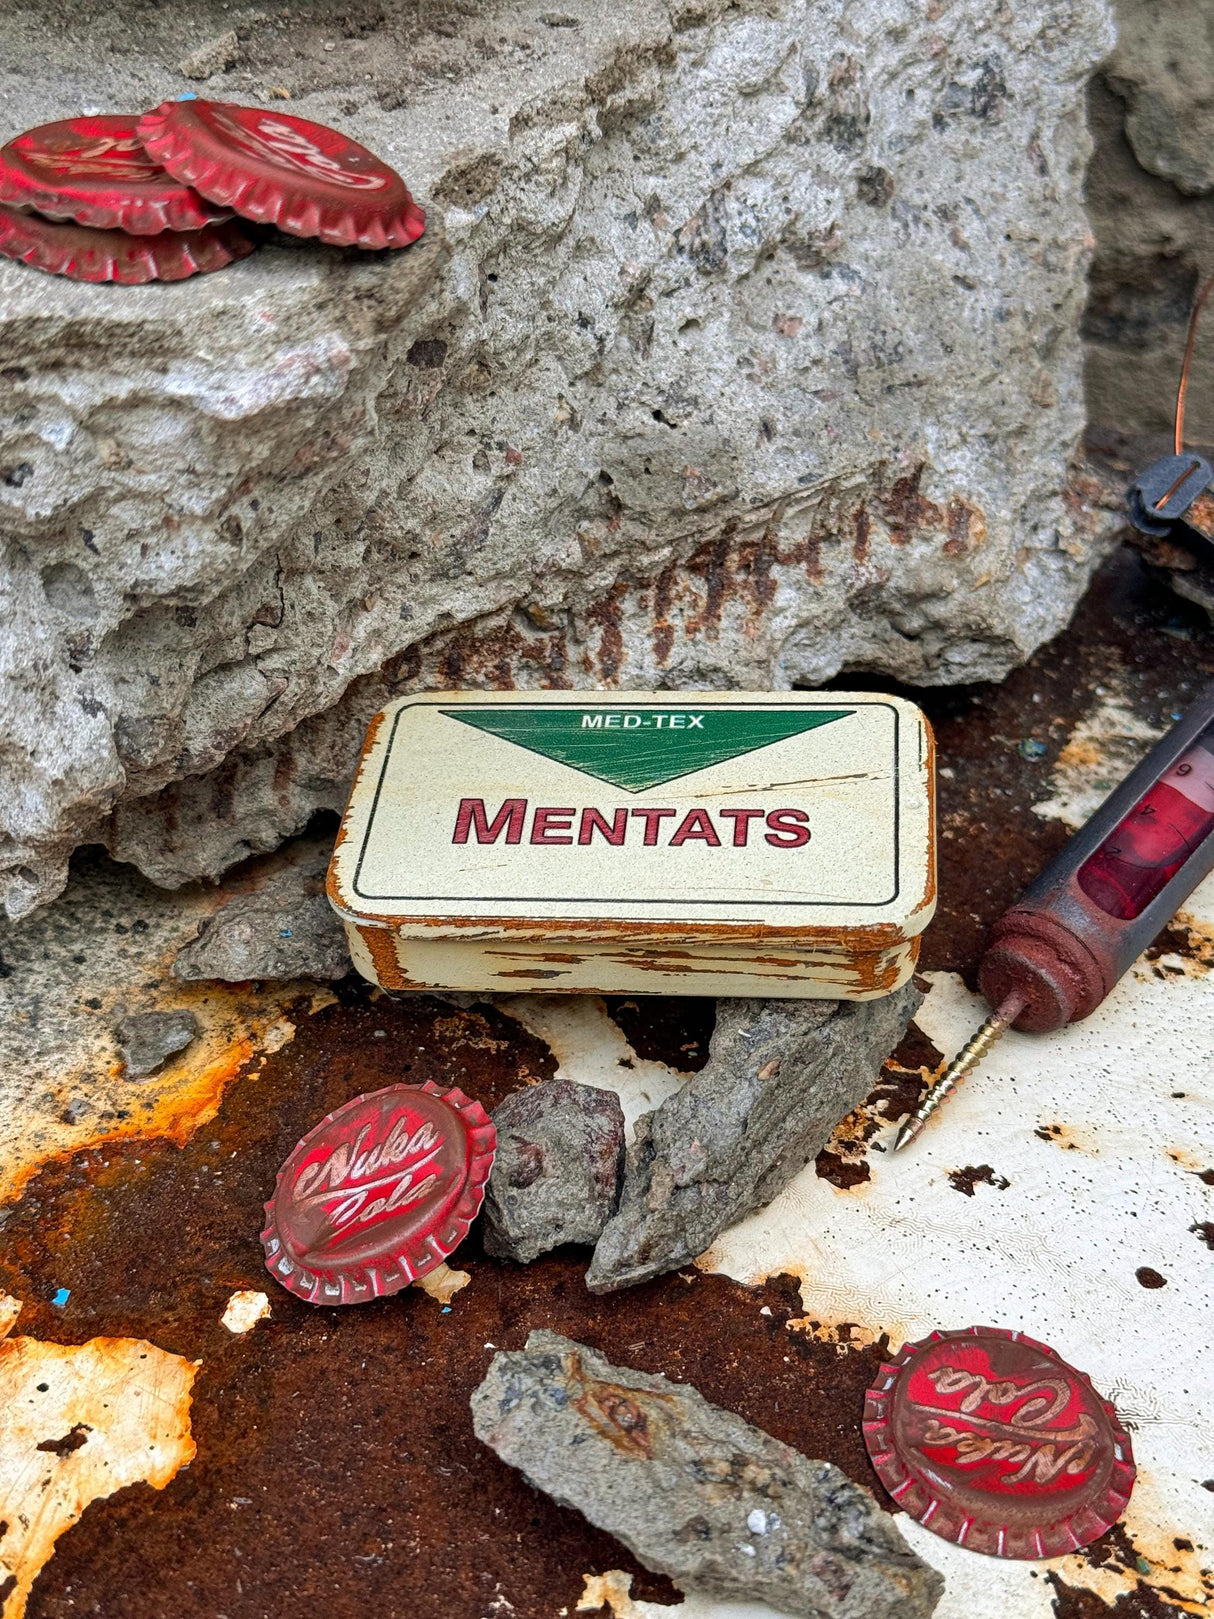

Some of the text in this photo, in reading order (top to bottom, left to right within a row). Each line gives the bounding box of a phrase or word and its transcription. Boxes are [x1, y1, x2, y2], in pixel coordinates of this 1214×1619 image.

[581, 715, 705, 729] MED-TEX
[451, 798, 812, 848] MENTATS
[1141, 804, 1156, 816] 4
[1103, 846, 1122, 860] 2
[294, 1116, 440, 1200] Nuka
[927, 1367, 1071, 1427] Cola
[923, 1420, 1095, 1484] Nuka
